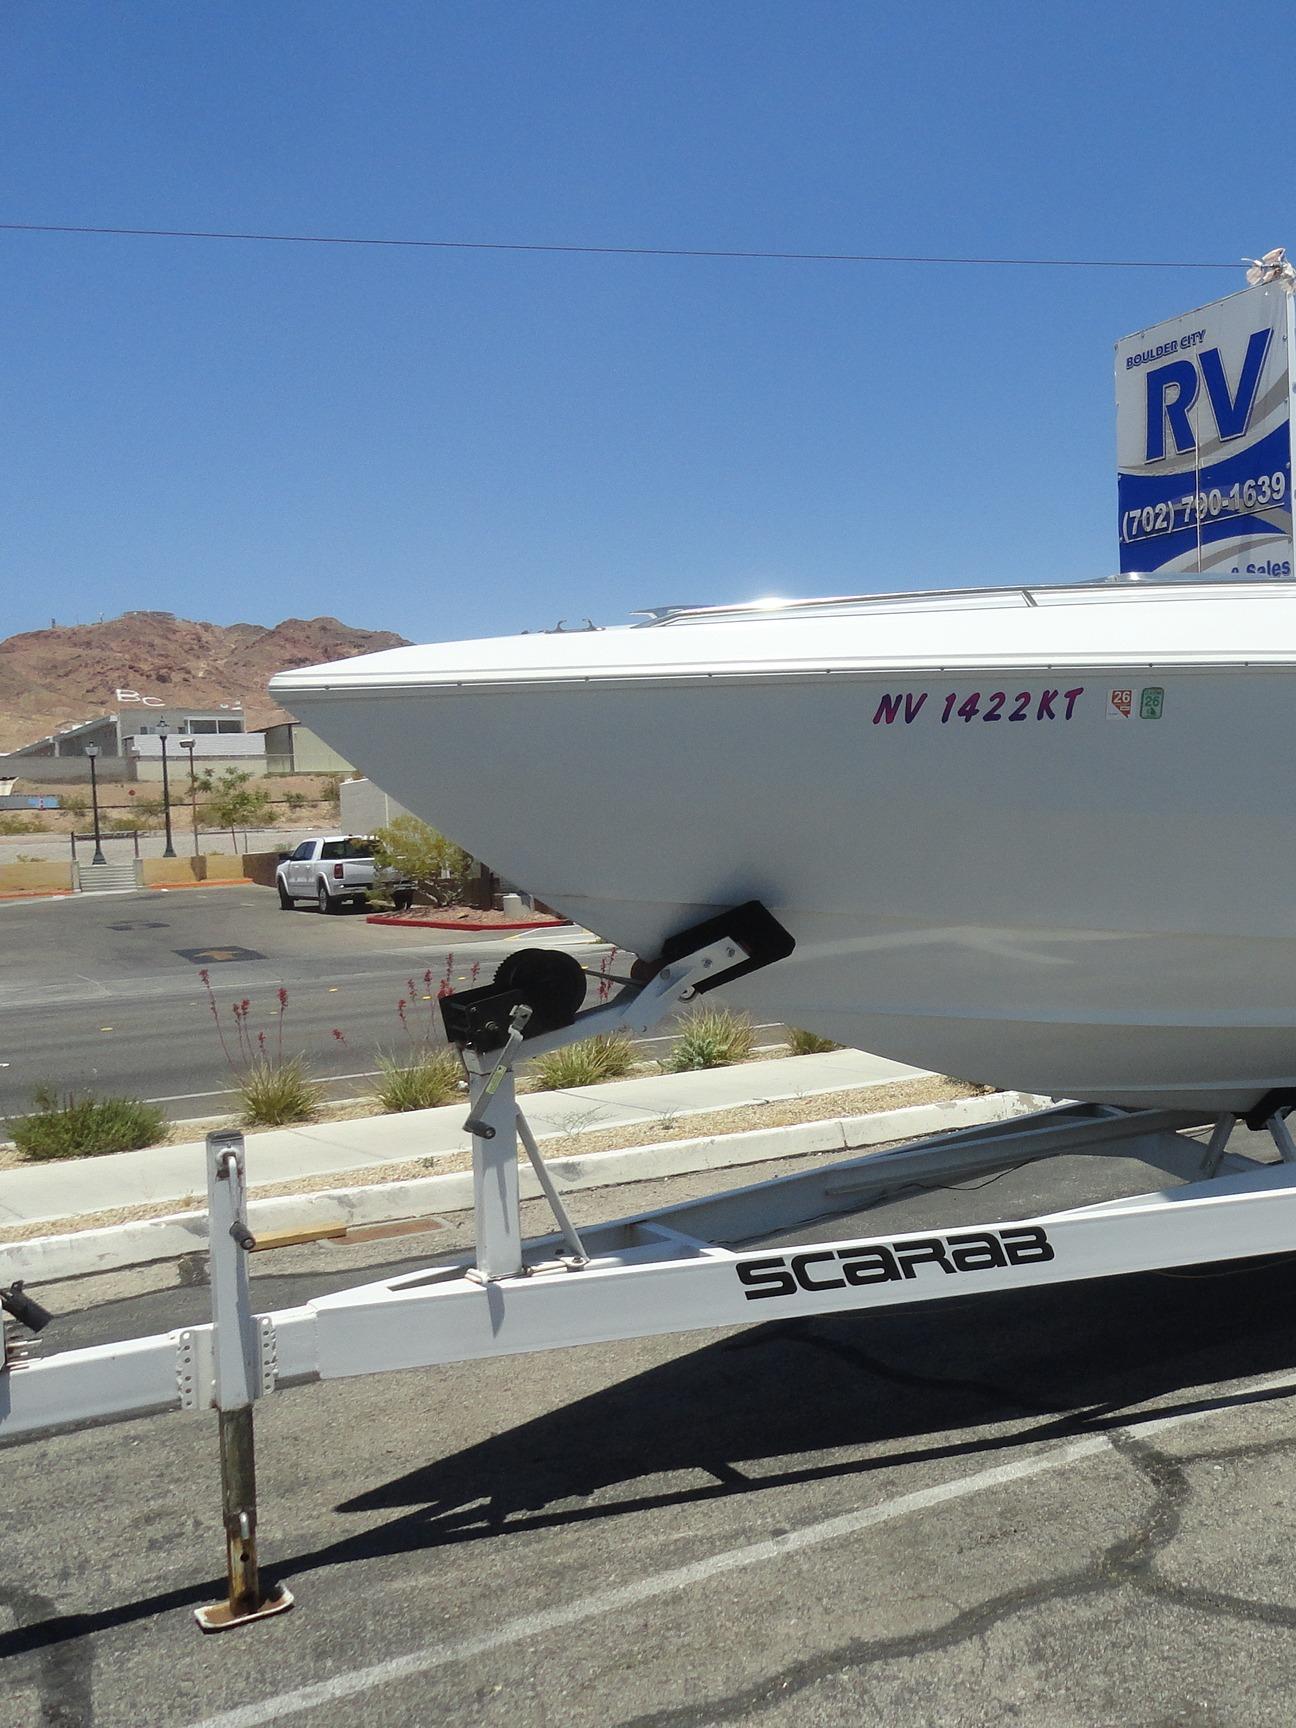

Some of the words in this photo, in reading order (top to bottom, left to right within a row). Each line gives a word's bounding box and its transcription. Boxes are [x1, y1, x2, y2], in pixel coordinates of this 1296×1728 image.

[1126, 340, 1178, 370] BOULDER
[1180, 329, 1207, 350] CITY
[1144, 327, 1274, 465] RV
[1122, 501, 1174, 543] (702)
[1181, 471, 1286, 523] 790-1639
[872, 692, 928, 724] NV
[1113, 691, 1131, 703] 26
